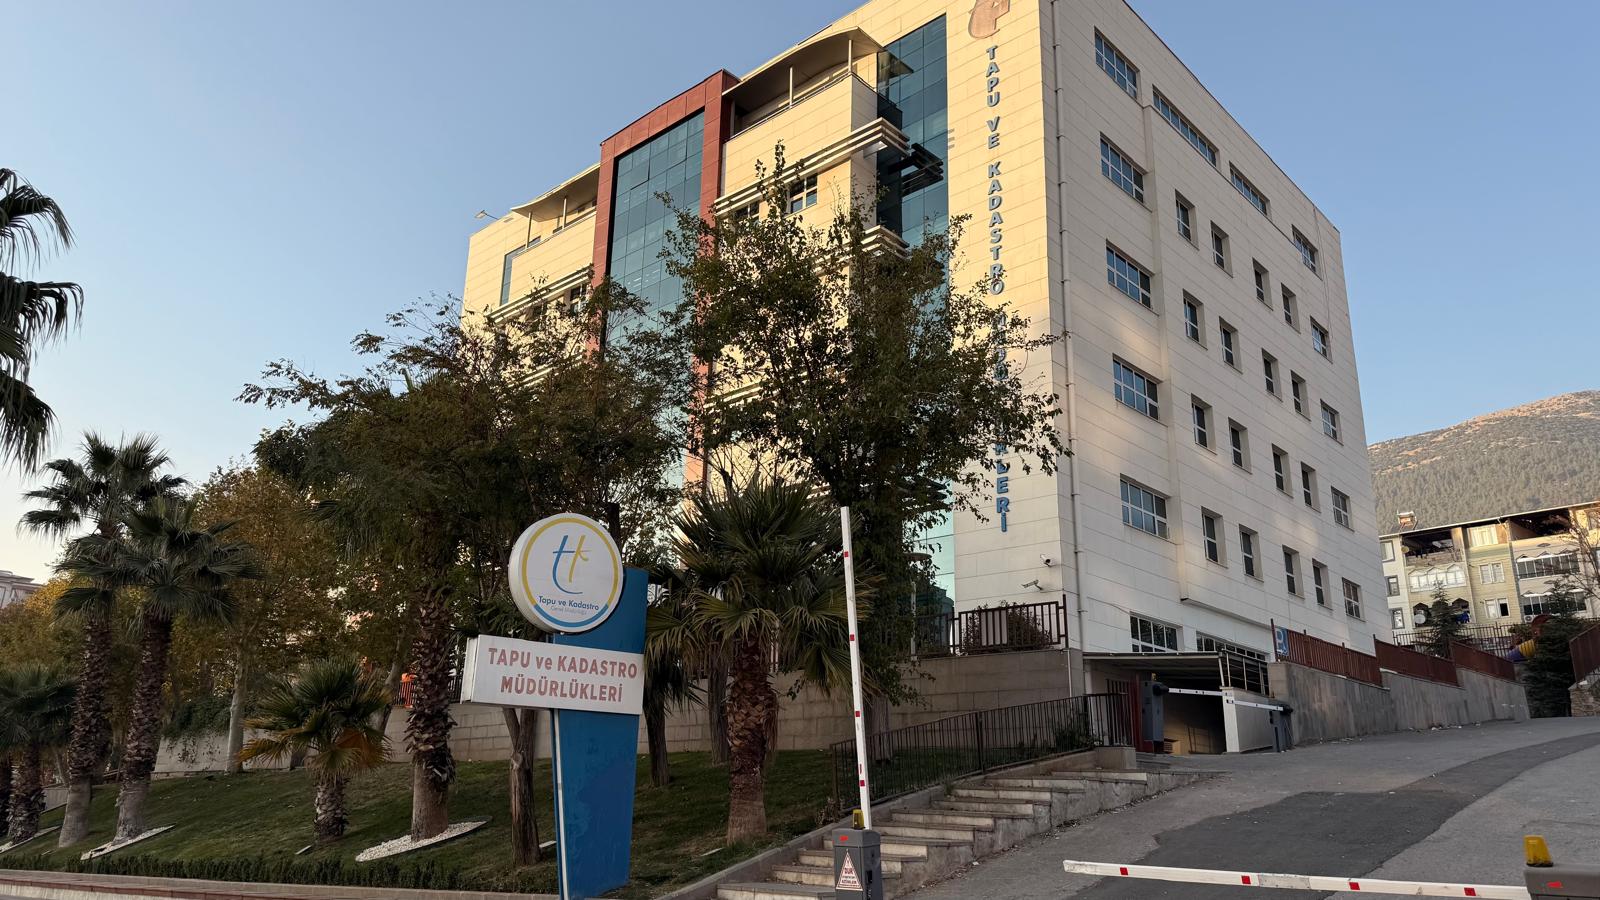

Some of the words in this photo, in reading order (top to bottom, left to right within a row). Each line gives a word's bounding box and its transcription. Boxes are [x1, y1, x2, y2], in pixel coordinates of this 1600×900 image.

[986, 45, 1000, 108] TAPU
[986, 116, 1001, 150] VE
[988, 161, 1005, 296] KADASTRO
[539, 596, 556, 605] Tapu
[569, 600, 599, 610] Kadastro
[488, 647, 531, 668] TAPU
[535, 656, 553, 670] ve
[557, 655, 637, 678] KADASTRO
[500, 673, 623, 702] MÜDÜRLÜKLERİ
